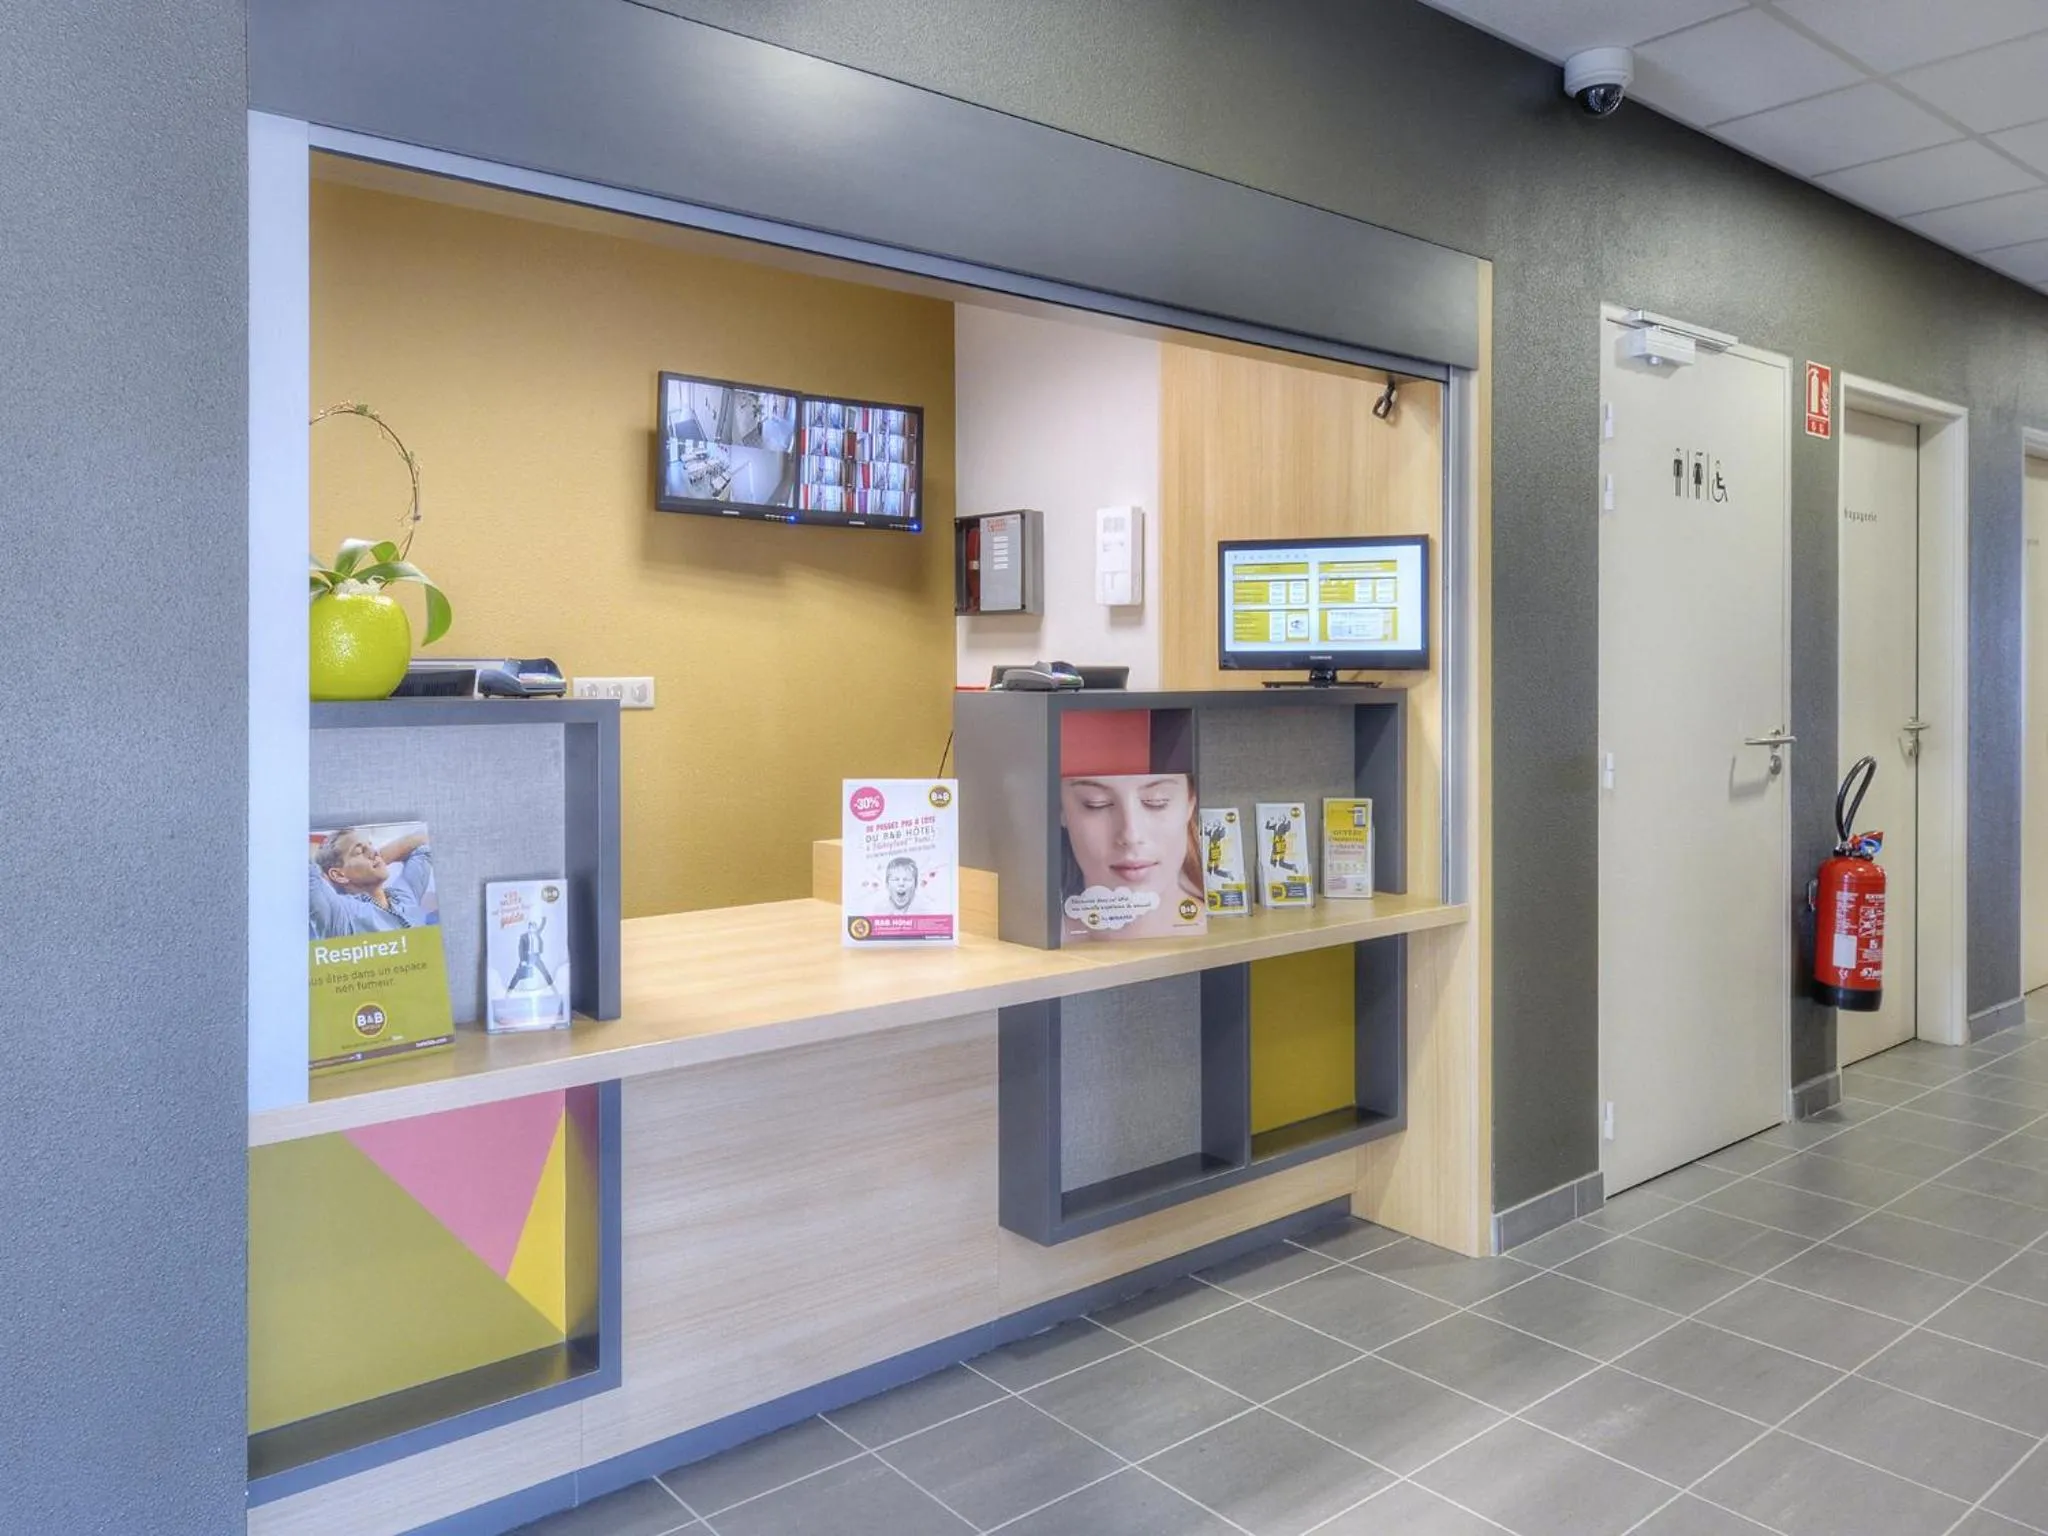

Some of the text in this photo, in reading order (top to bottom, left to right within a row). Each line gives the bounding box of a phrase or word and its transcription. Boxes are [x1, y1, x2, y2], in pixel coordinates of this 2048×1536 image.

[314, 936, 407, 965] Respirez !
[393, 962, 427, 976] espace
[357, 1011, 383, 1027] B&B
